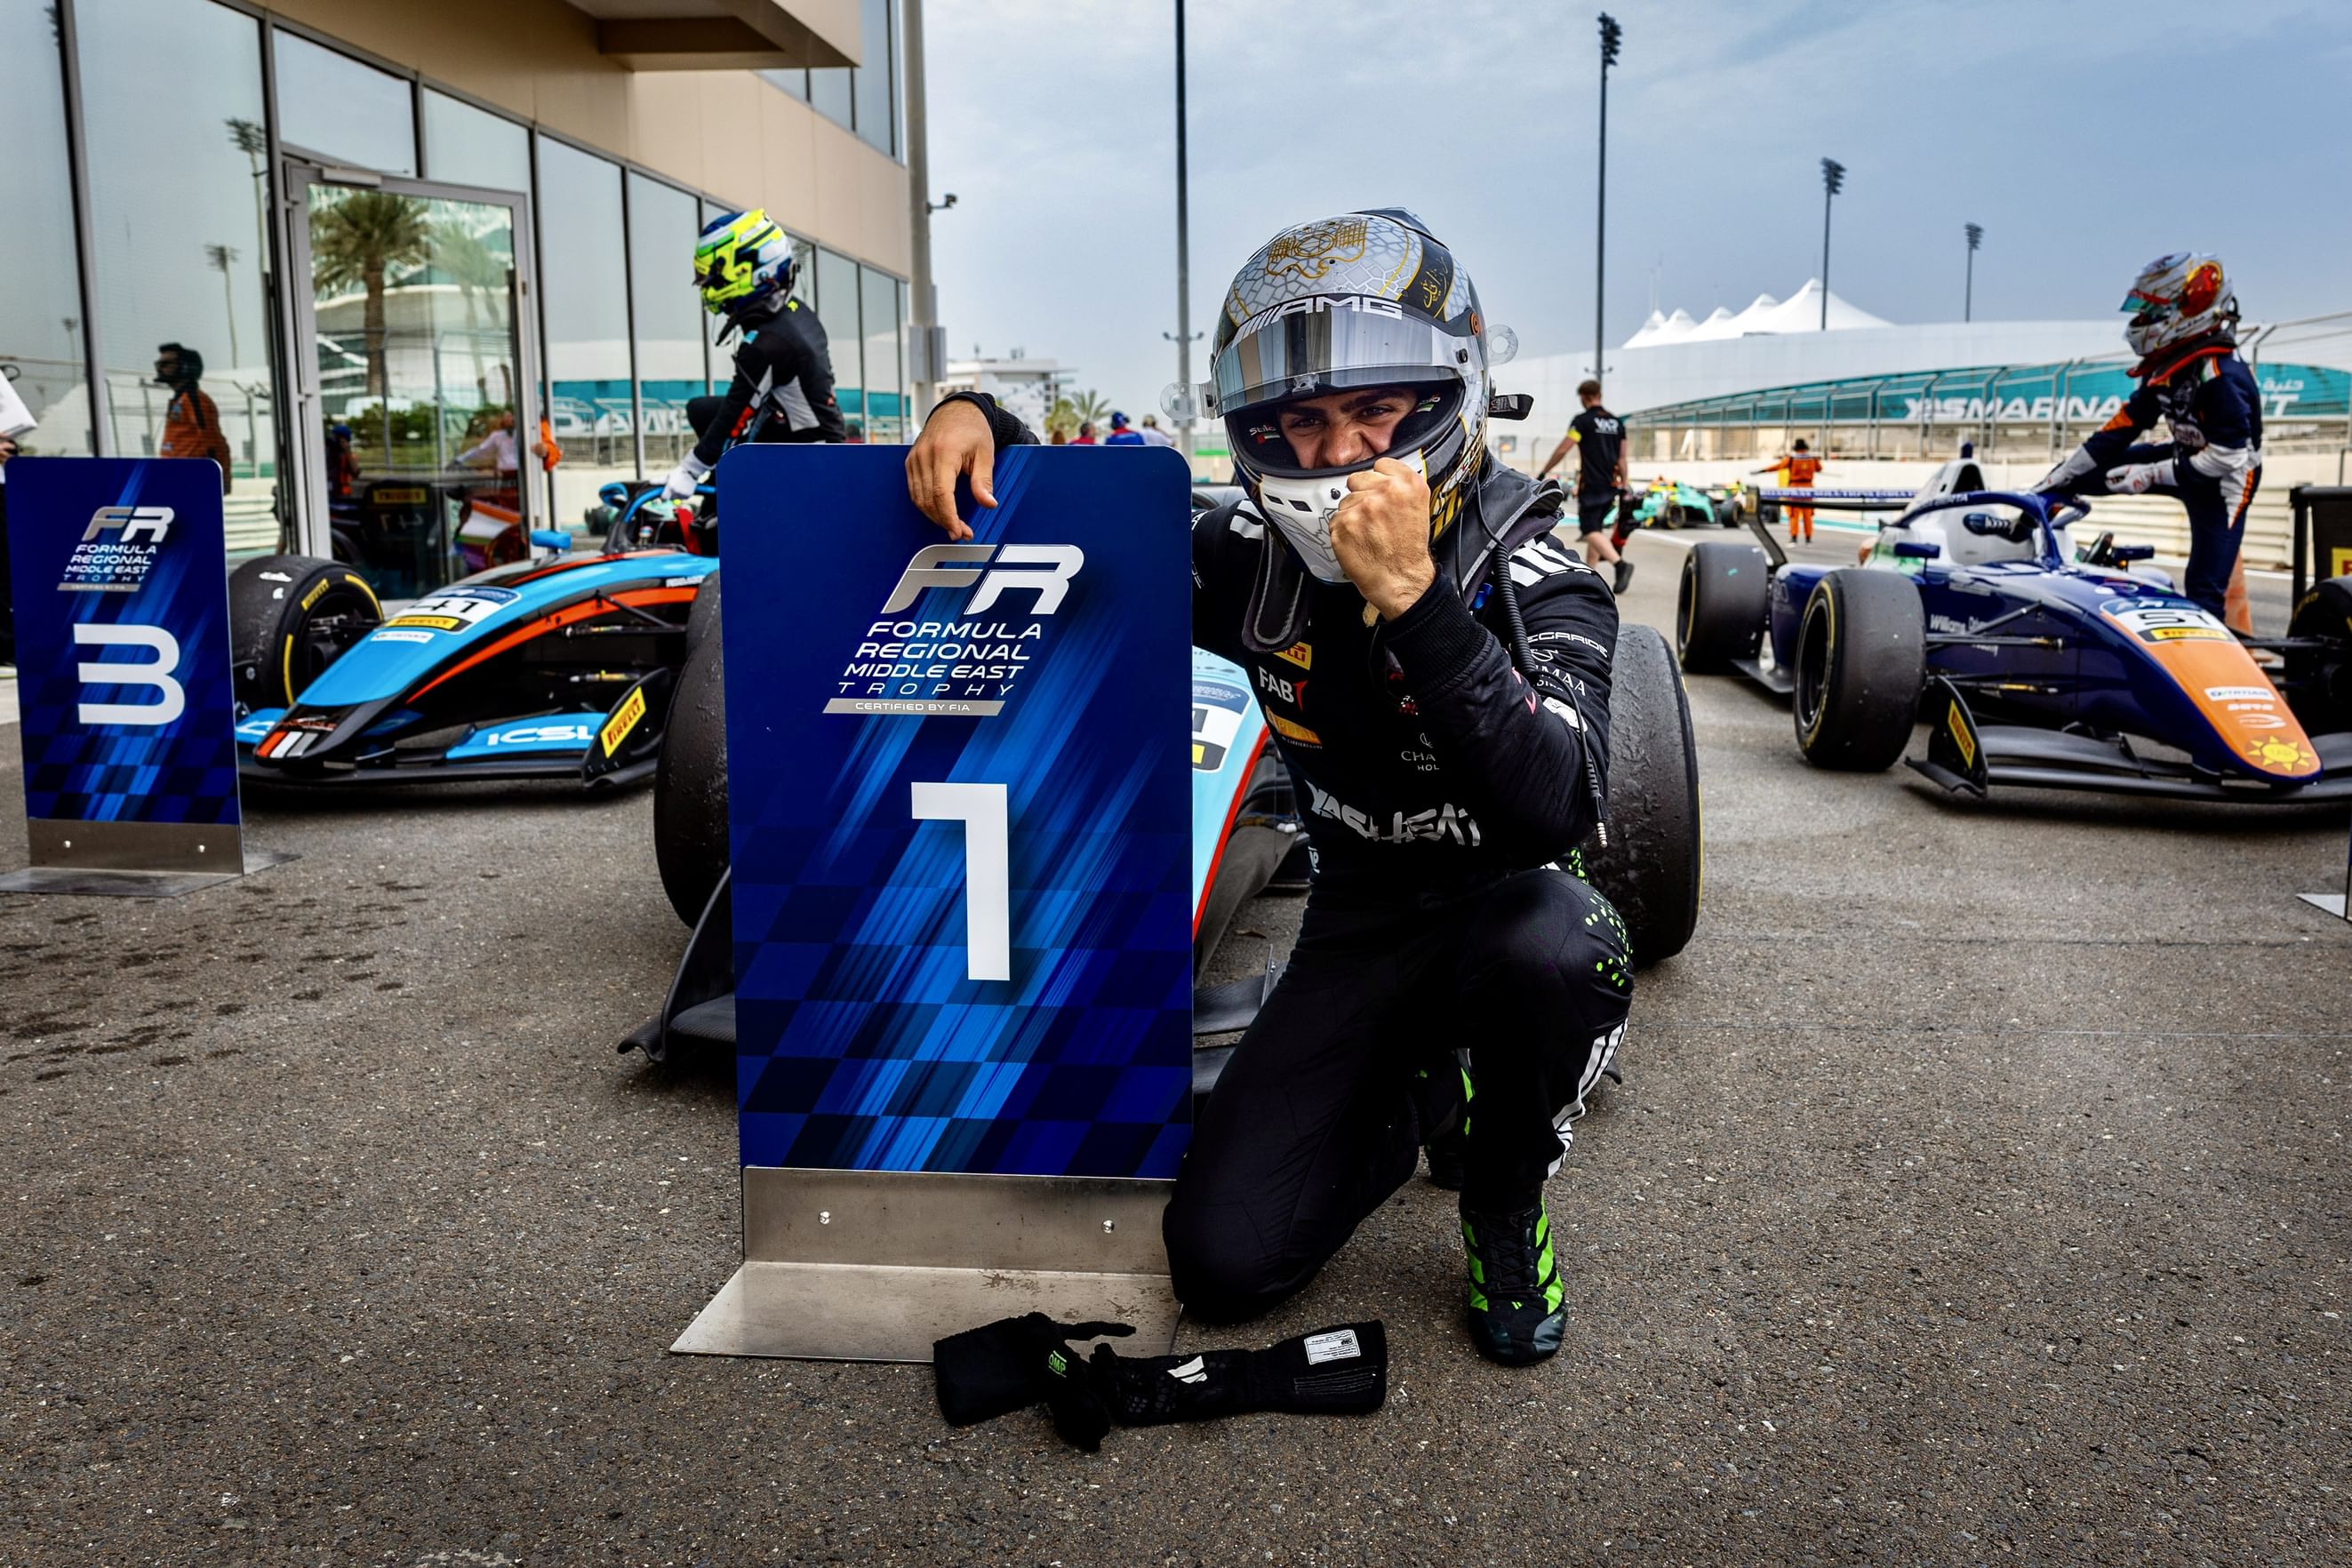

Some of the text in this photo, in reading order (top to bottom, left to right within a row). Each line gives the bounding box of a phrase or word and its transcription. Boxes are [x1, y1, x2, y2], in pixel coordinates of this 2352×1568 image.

[1270, 296, 1403, 324] AMG
[81, 506, 175, 542] FR
[75, 544, 156, 555] FORMULA
[70, 555, 152, 564] REGIONAL
[63, 573, 145, 582] TROPHY
[65, 564, 149, 574] MIDDLE EAST
[881, 544, 1084, 615] FR
[867, 621, 1042, 639] FORMULA
[854, 642, 1031, 660] REGIONAL
[1527, 631, 1608, 658] EGARIDE
[73, 623, 186, 726] 3
[844, 663, 1025, 679] MIDDLE EAST
[838, 682, 1015, 696] TROPHY
[855, 702, 971, 712] CERTIFIED BY FIA
[607, 696, 641, 747] PIRELLI
[911, 781, 1010, 981] 1
[1049, 1352, 1066, 1374] OMP
